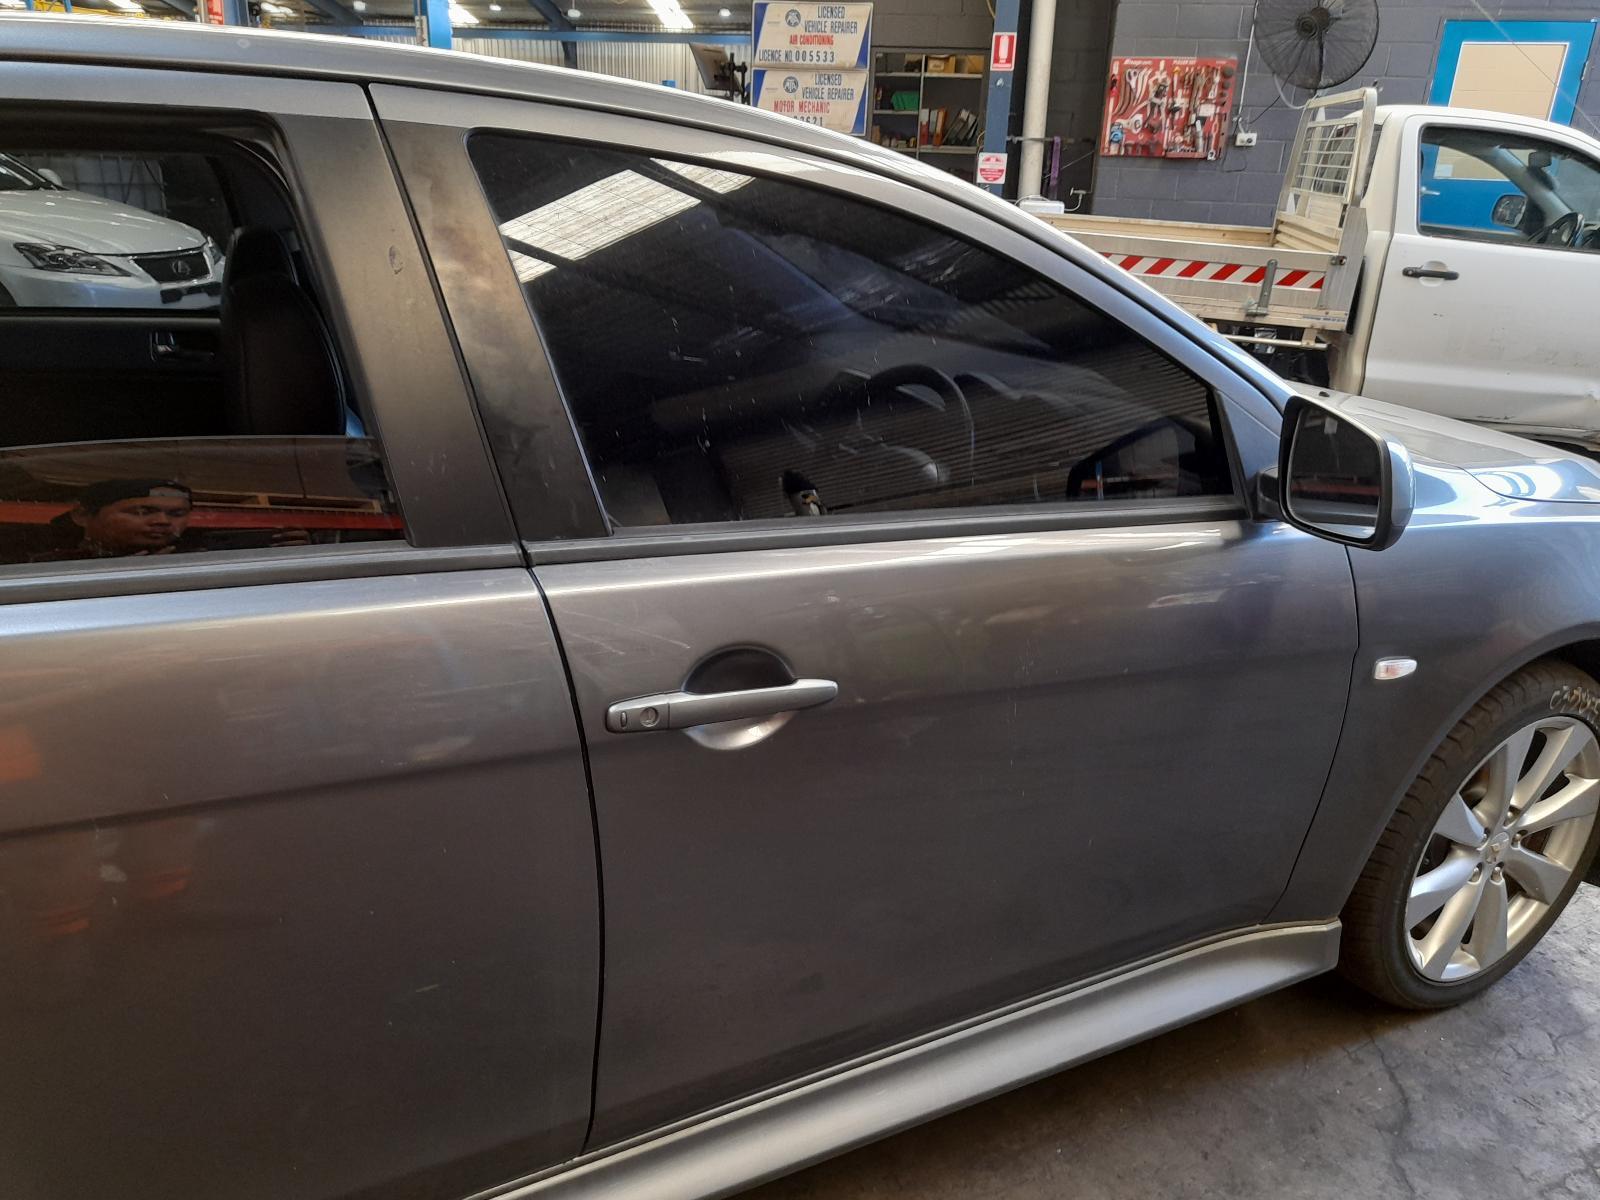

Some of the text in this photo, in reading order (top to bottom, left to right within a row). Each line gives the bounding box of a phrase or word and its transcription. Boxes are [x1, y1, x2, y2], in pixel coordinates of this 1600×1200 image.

[817, 6, 846, 18] LICENSED
[804, 20, 858, 35] VEHICLE REPAIRER
[789, 34, 834, 46] AIR CONDITIONING
[758, 49, 782, 62] LICENCE
[814, 74, 842, 86] LICENSED
[801, 87, 855, 101] VEHICLE REPAIRER
[774, 100, 831, 115] MOTOR MECHANIC
